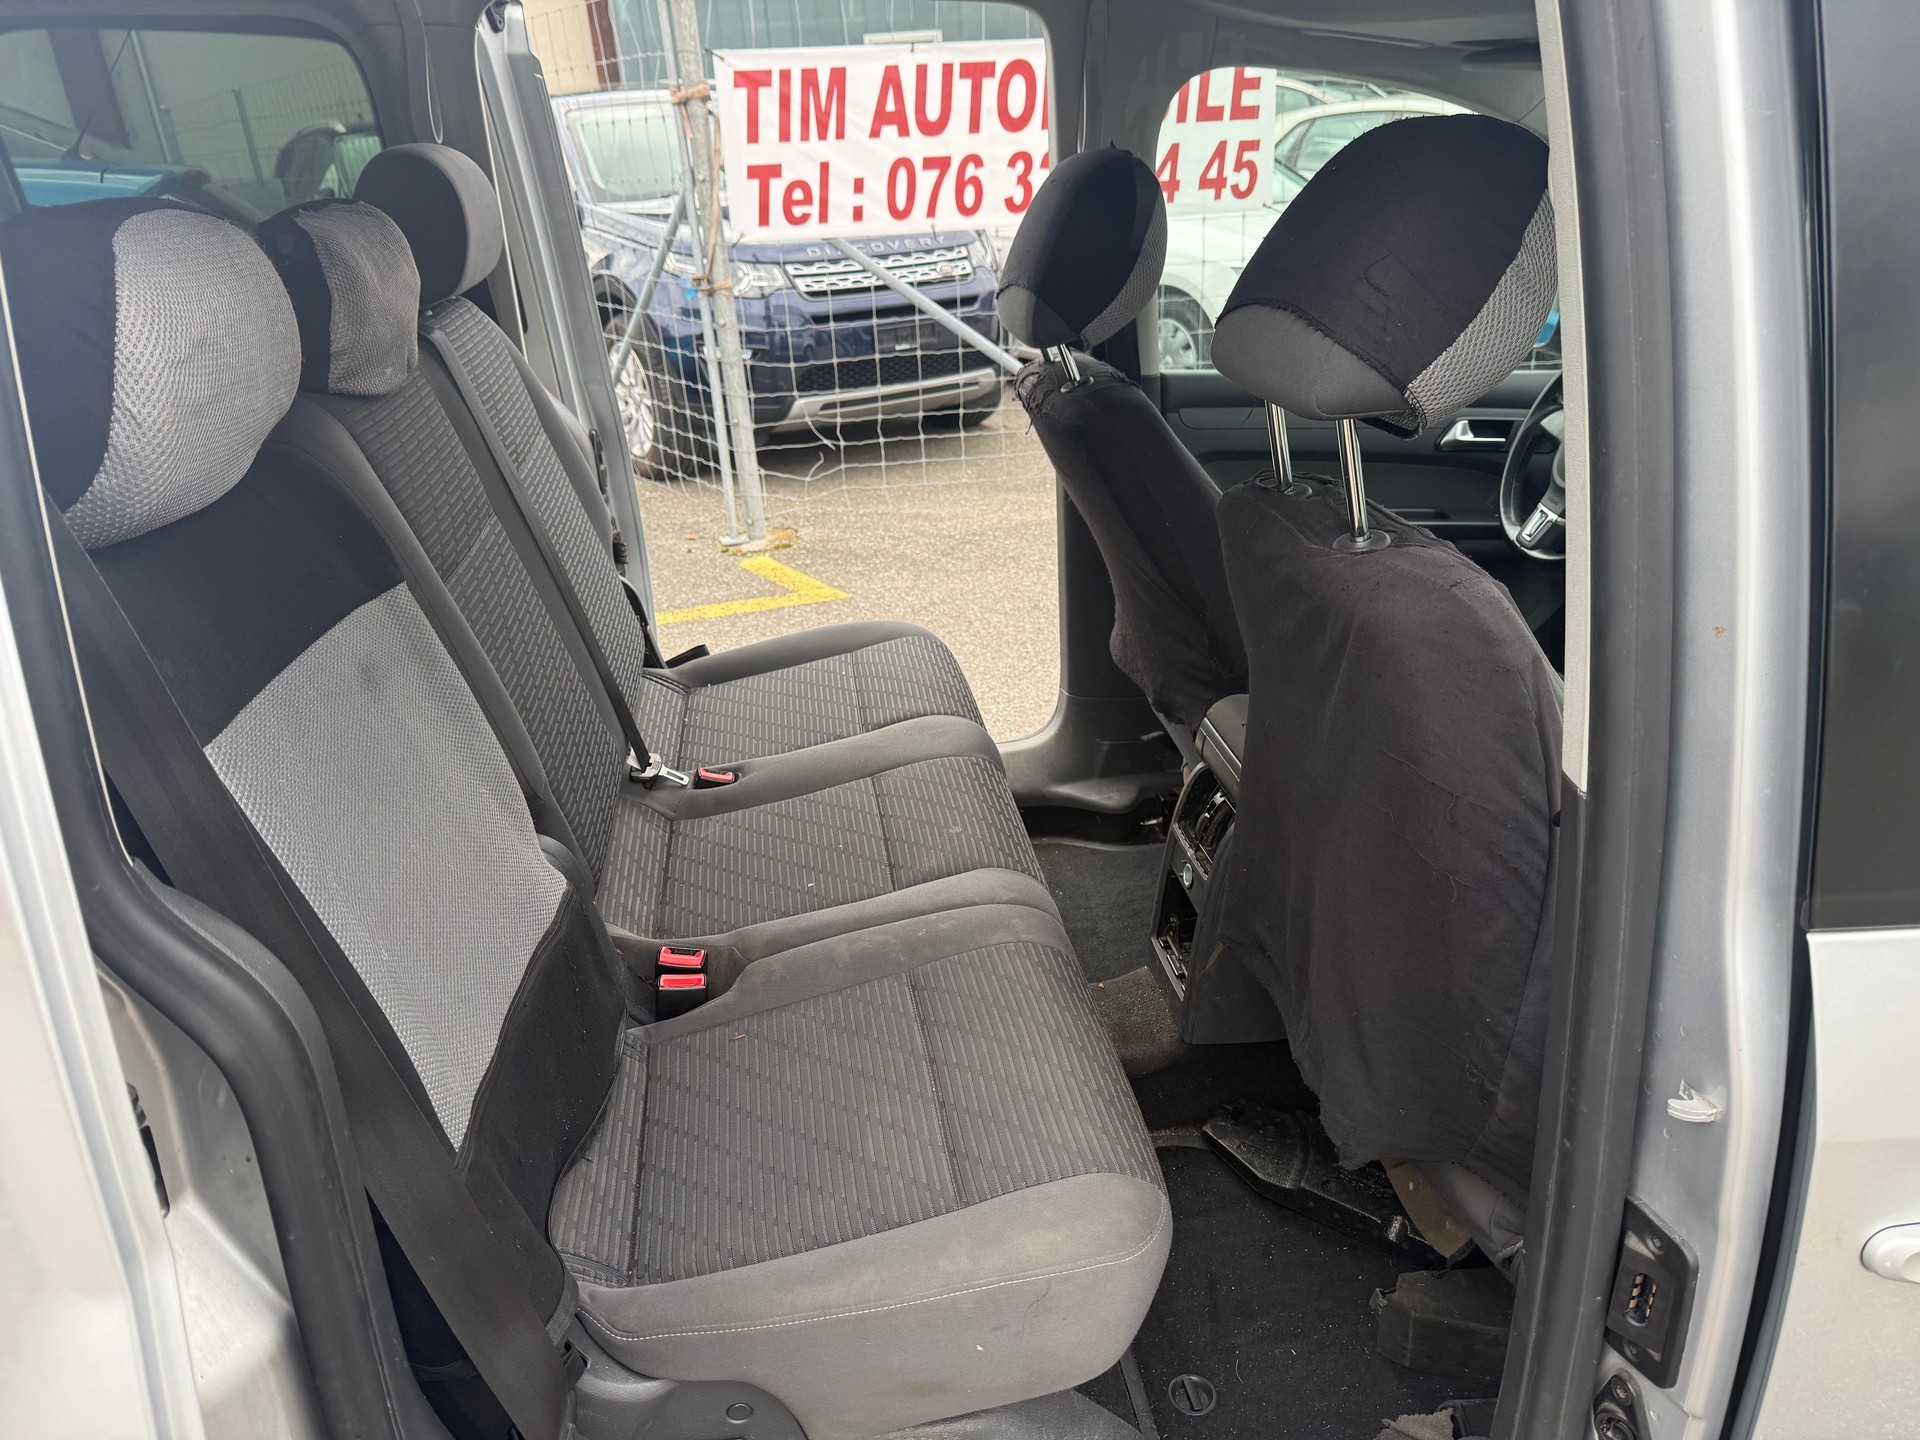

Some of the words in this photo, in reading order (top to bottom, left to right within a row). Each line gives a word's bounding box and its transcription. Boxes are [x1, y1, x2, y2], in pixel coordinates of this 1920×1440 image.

[733, 66, 847, 144] TIM
[868, 58, 1049, 139] AUTO
[1163, 67, 1262, 124] ILE
[746, 161, 830, 227] Tel
[886, 153, 985, 221] 076
[1198, 139, 1261, 201] 45
[806, 235, 944, 258] DICOVERY
